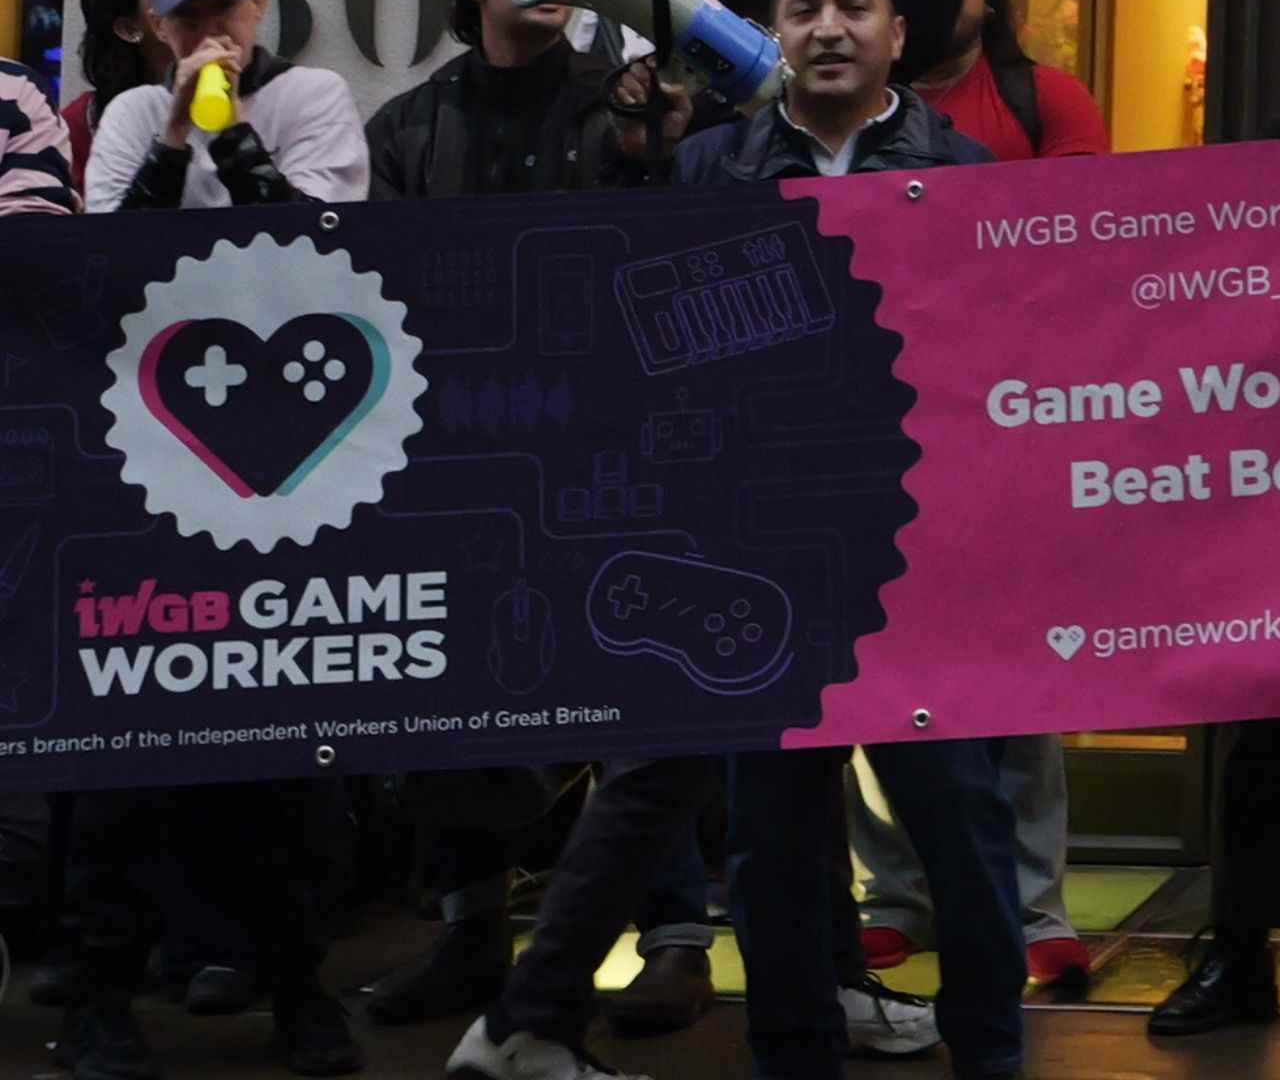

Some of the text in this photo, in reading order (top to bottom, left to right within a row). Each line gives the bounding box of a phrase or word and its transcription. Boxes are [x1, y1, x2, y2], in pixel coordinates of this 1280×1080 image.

[976, 214, 1078, 249] IWGB
[1091, 210, 1195, 240] Game
[987, 380, 1162, 427] Game
[1071, 455, 1210, 508] Beat
[240, 571, 447, 630] GAME
[79, 631, 446, 696] WORKERS
[33, 734, 105, 753] branch
[111, 731, 133, 749] of
[139, 729, 173, 748] the
[178, 720, 308, 746] Independent
[315, 718, 398, 738] Workers
[404, 714, 462, 732] Union
[468, 710, 490, 730] of
[495, 709, 551, 728] Great
[556, 704, 620, 725] Britain
